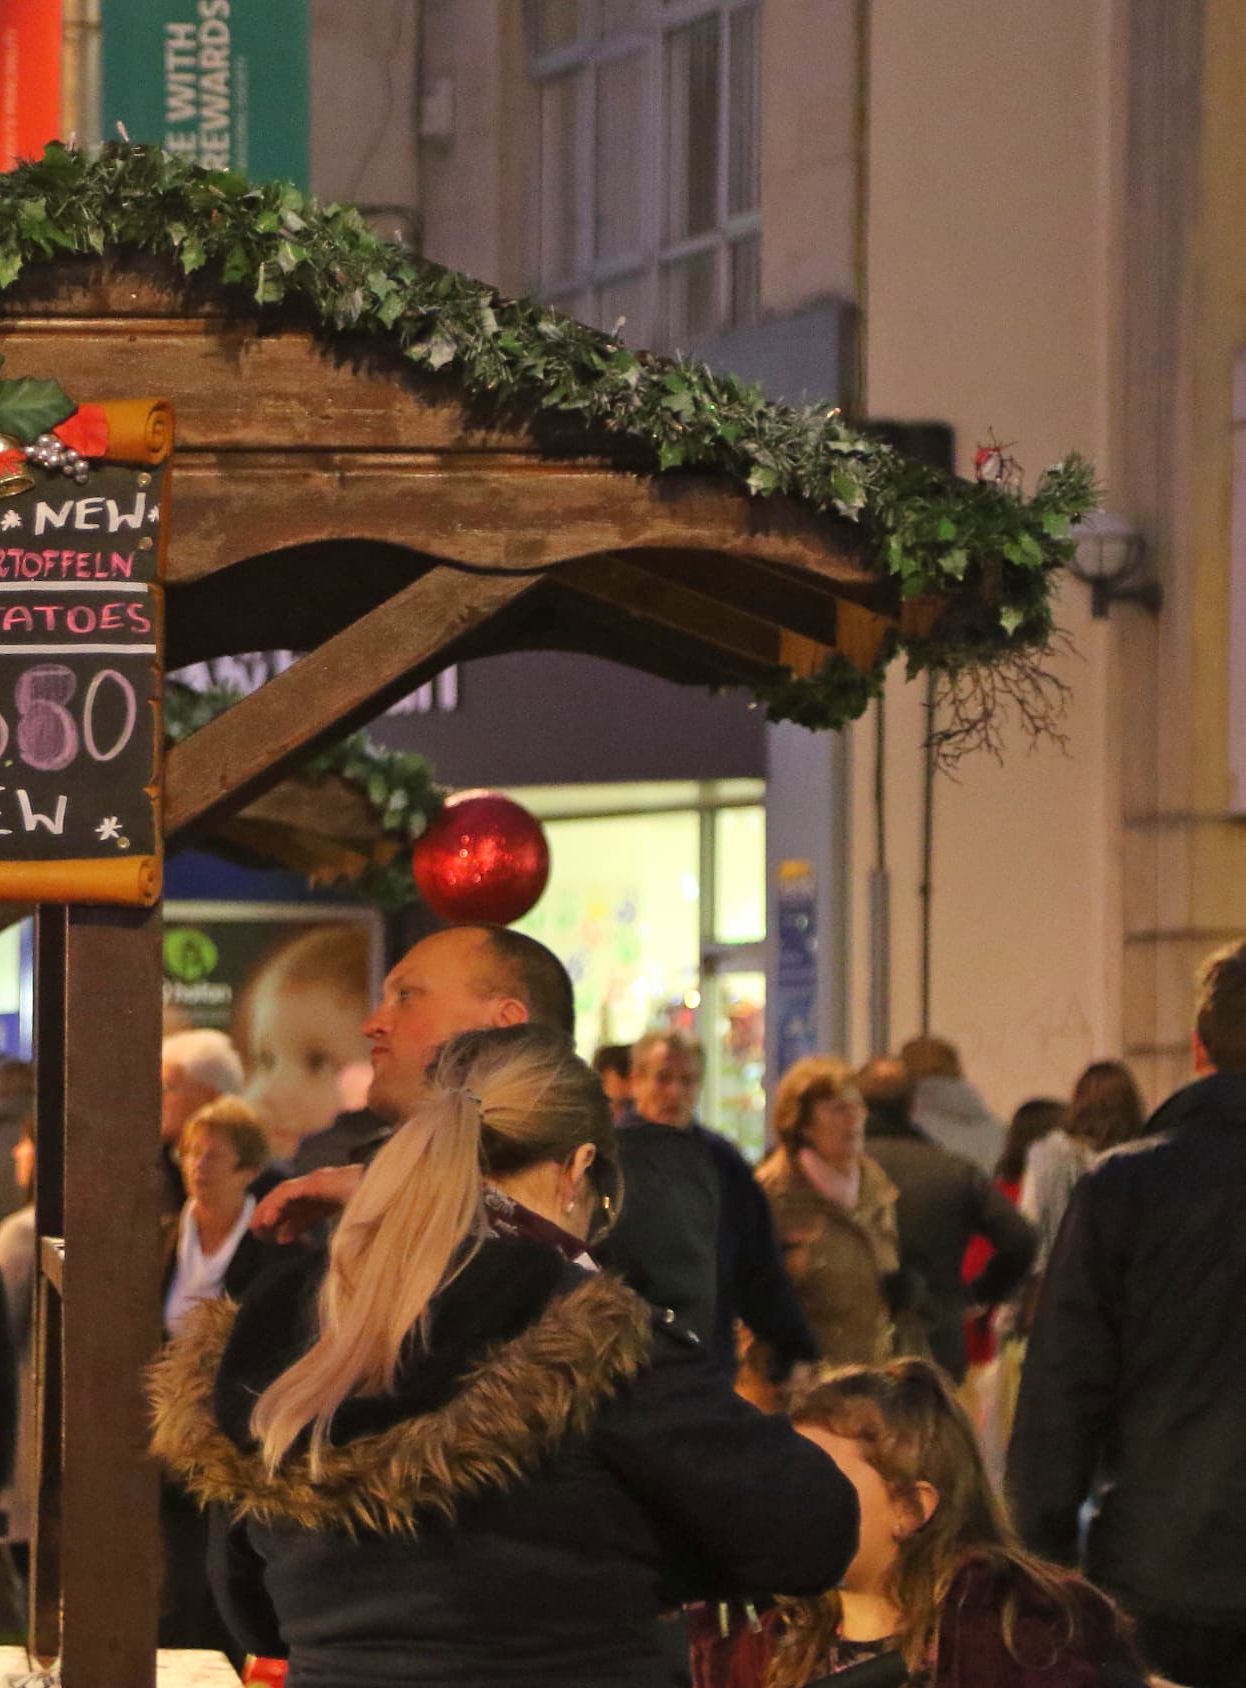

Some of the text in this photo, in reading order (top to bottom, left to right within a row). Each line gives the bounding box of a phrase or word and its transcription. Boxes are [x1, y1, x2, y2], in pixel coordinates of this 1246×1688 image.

[165, 21, 197, 122] WITH
[199, 0, 231, 171] REWARDS
[34, 492, 146, 535] NEW
